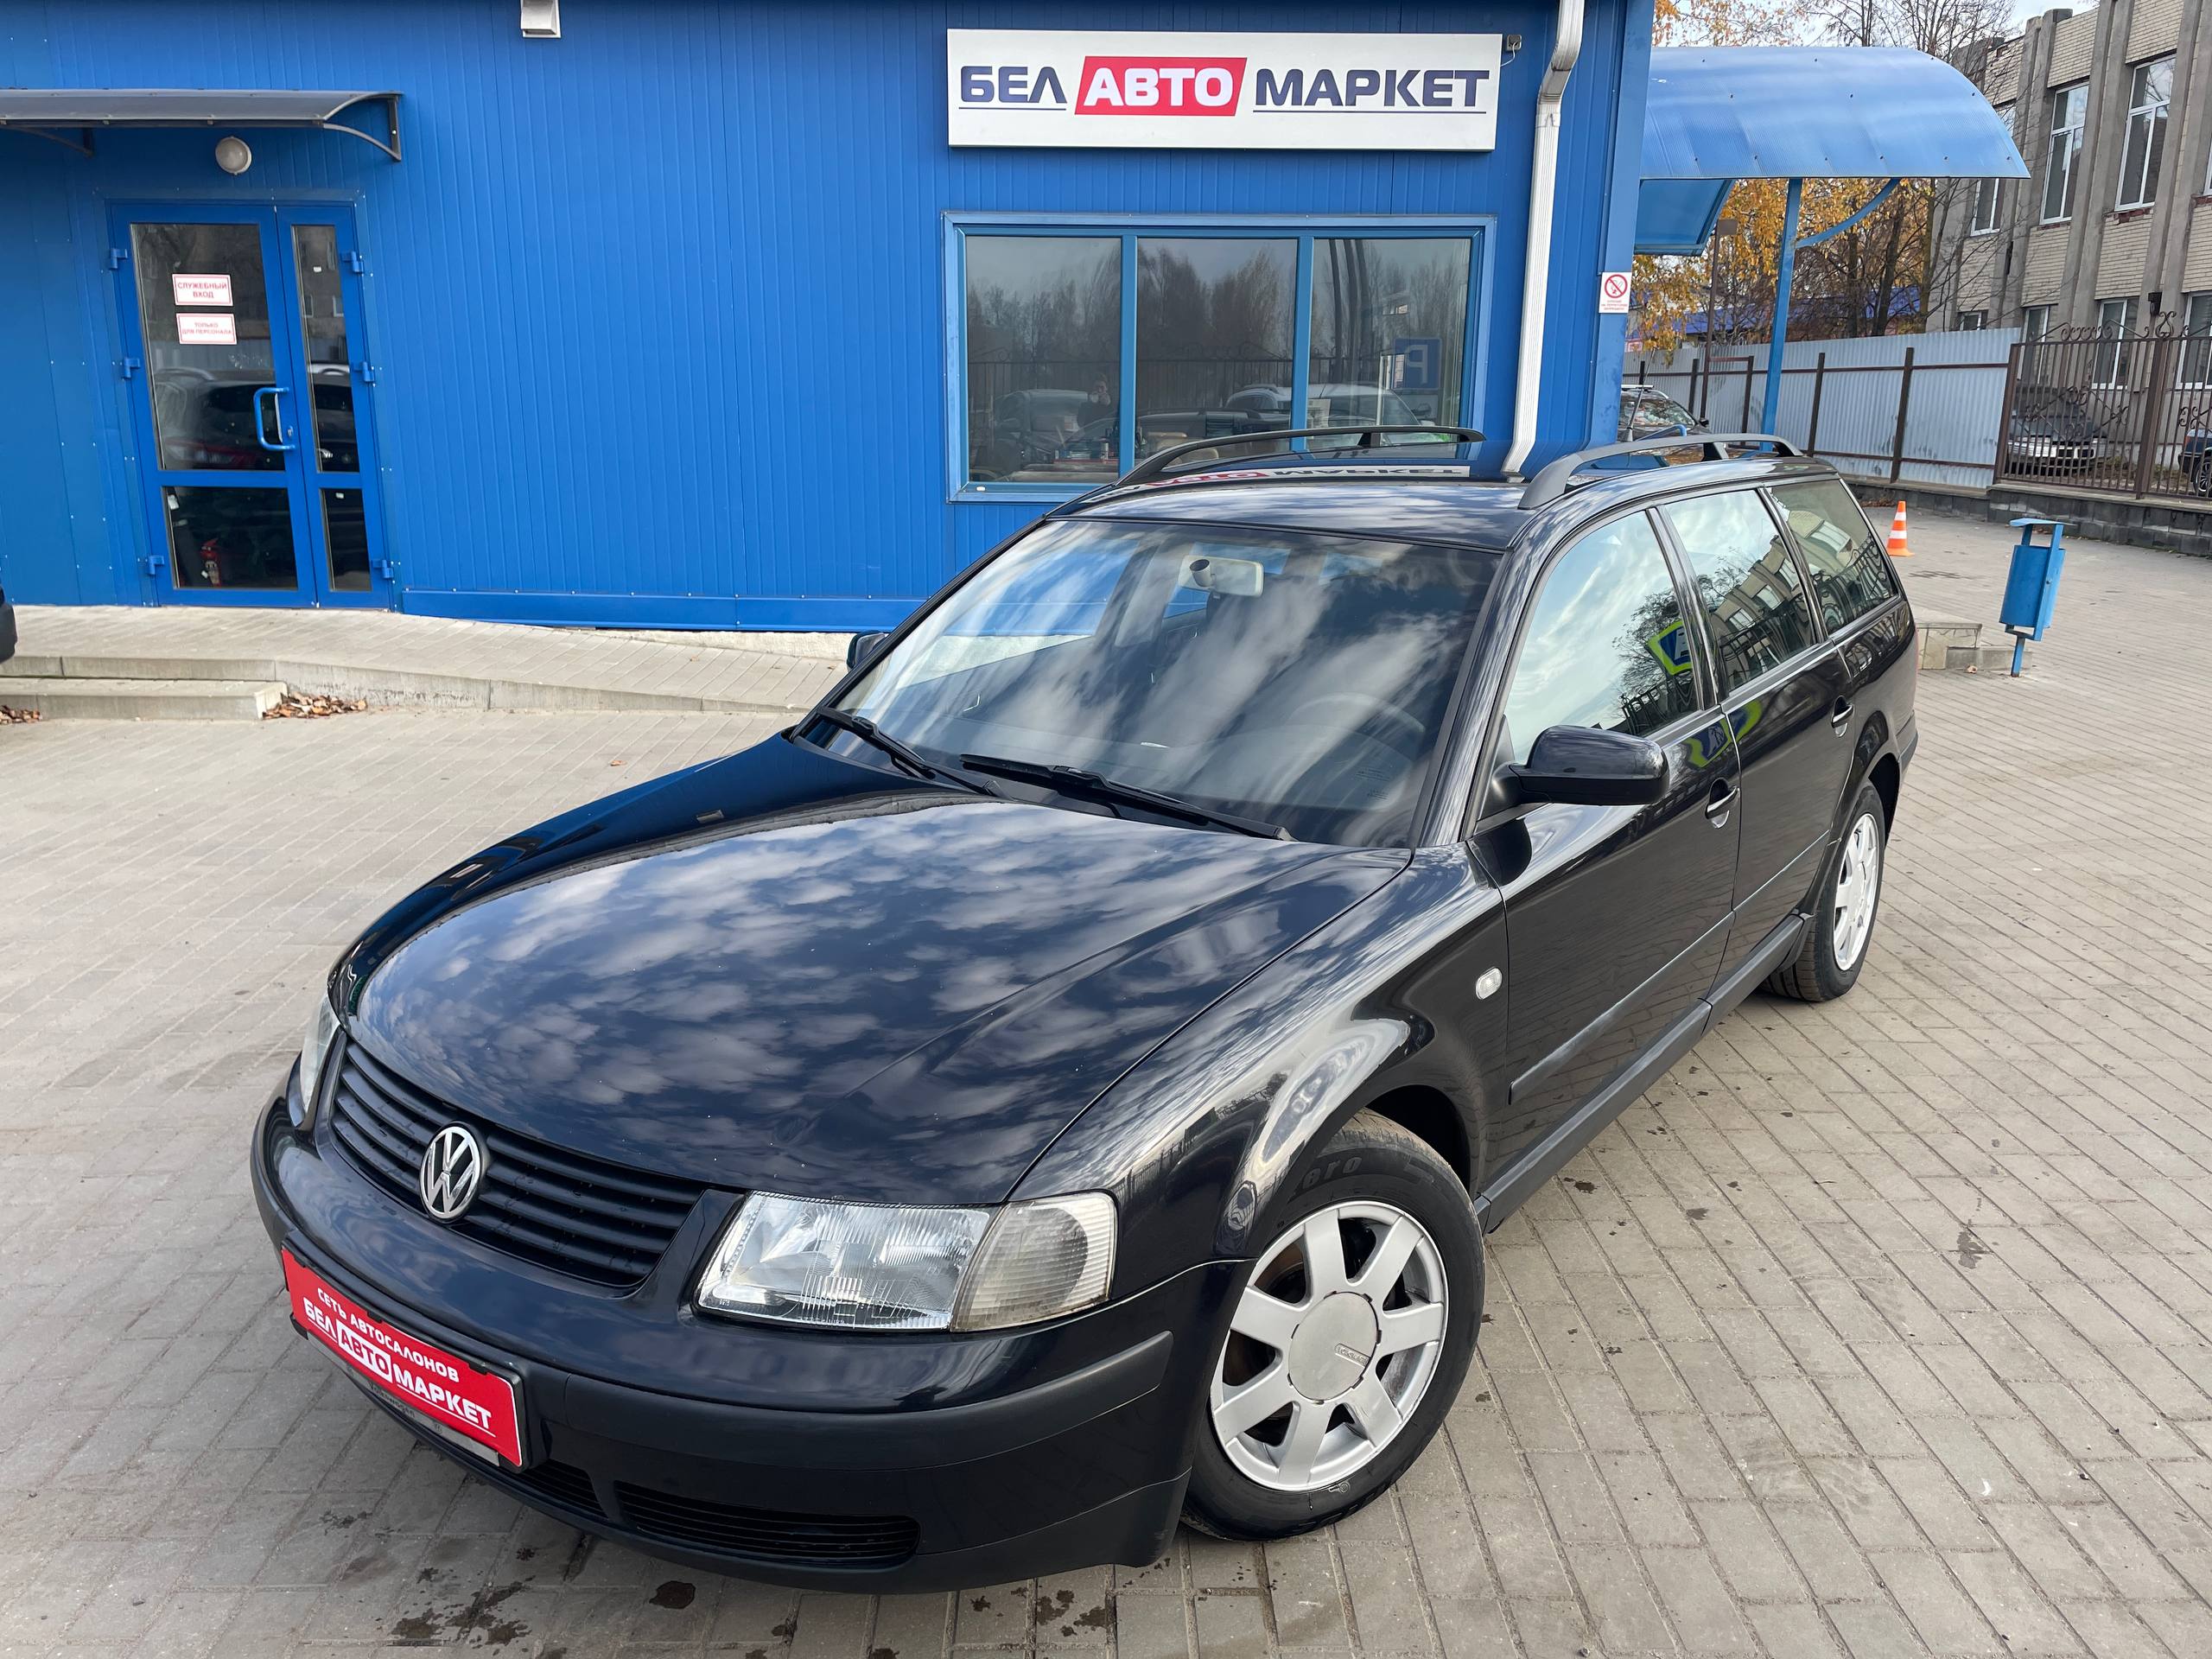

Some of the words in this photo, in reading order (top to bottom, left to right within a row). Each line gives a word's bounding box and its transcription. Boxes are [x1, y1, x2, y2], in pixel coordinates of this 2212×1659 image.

[960, 66, 1067, 105] БЕЛ
[1083, 67, 1234, 107] АВТО
[1255, 68, 1490, 108] МАРКЕТ
[303, 1297, 337, 1338] БЕЛ
[340, 1328, 391, 1380] АВТО
[393, 1363, 492, 1430] МАРКЕТ
[317, 1287, 346, 1319] СЕТЬ
[350, 1310, 460, 1382] АВТОСАЛОНОВ
